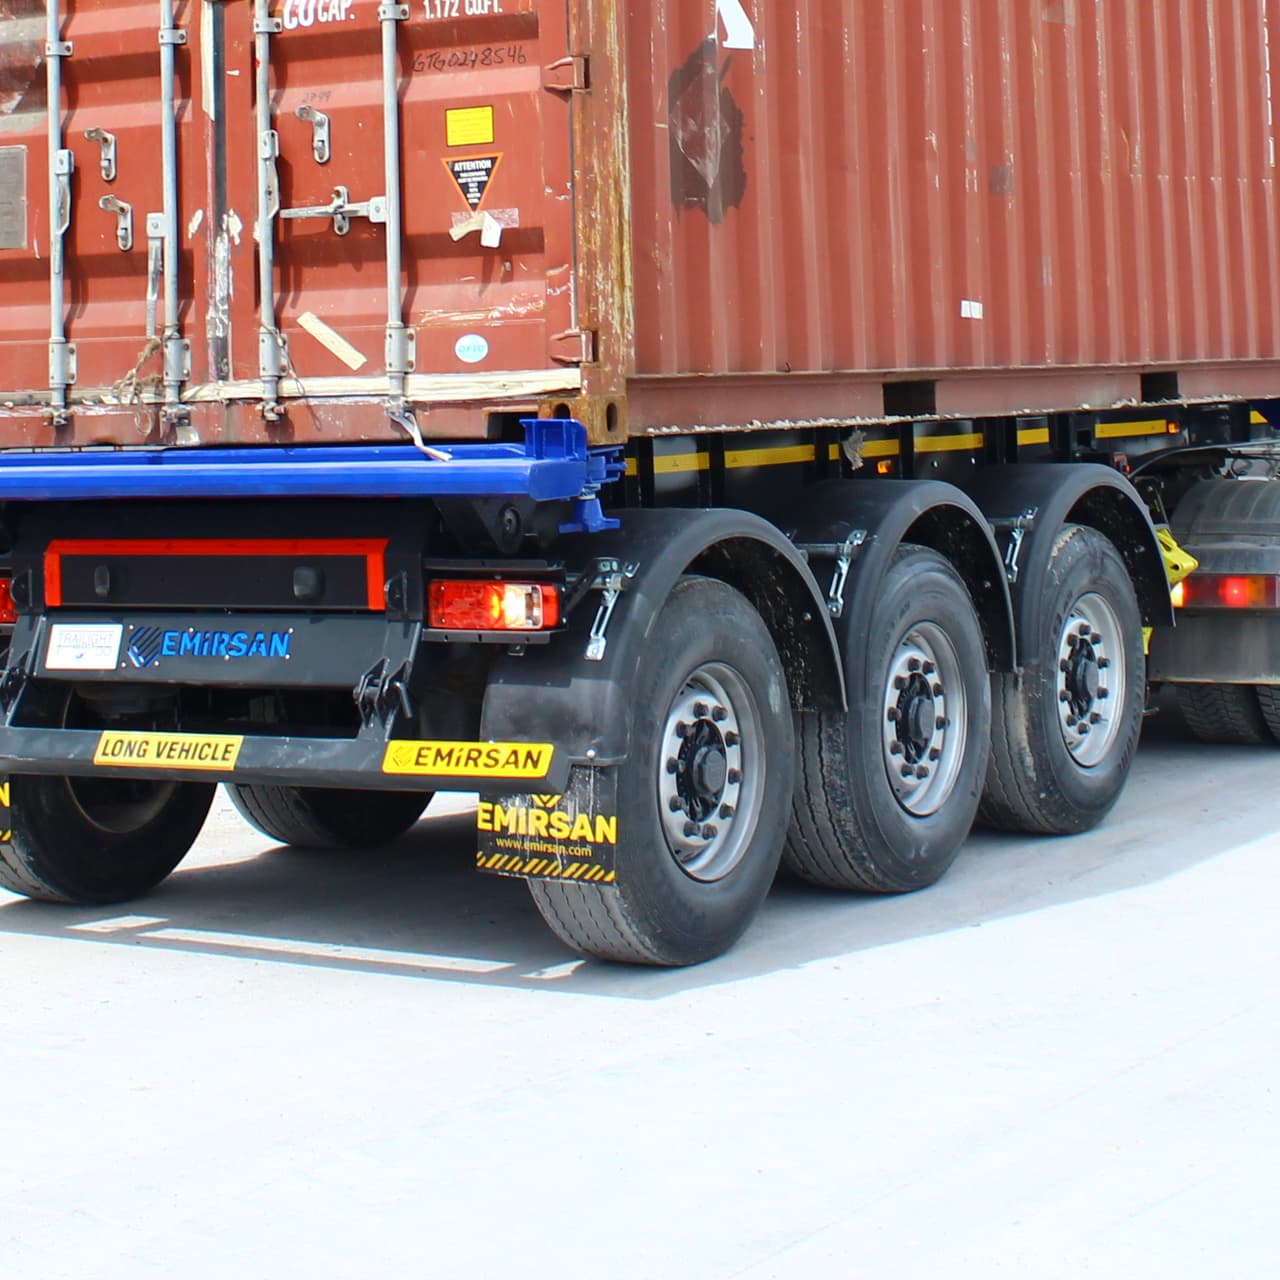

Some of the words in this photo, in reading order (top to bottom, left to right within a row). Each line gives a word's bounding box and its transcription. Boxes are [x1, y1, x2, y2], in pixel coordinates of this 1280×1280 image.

[454, 159, 492, 171] ATTENTION
[100, 737, 151, 759] LONG
[155, 738, 238, 763] VEHICLE
[496, 837, 592, 857] www.emirsan.com
